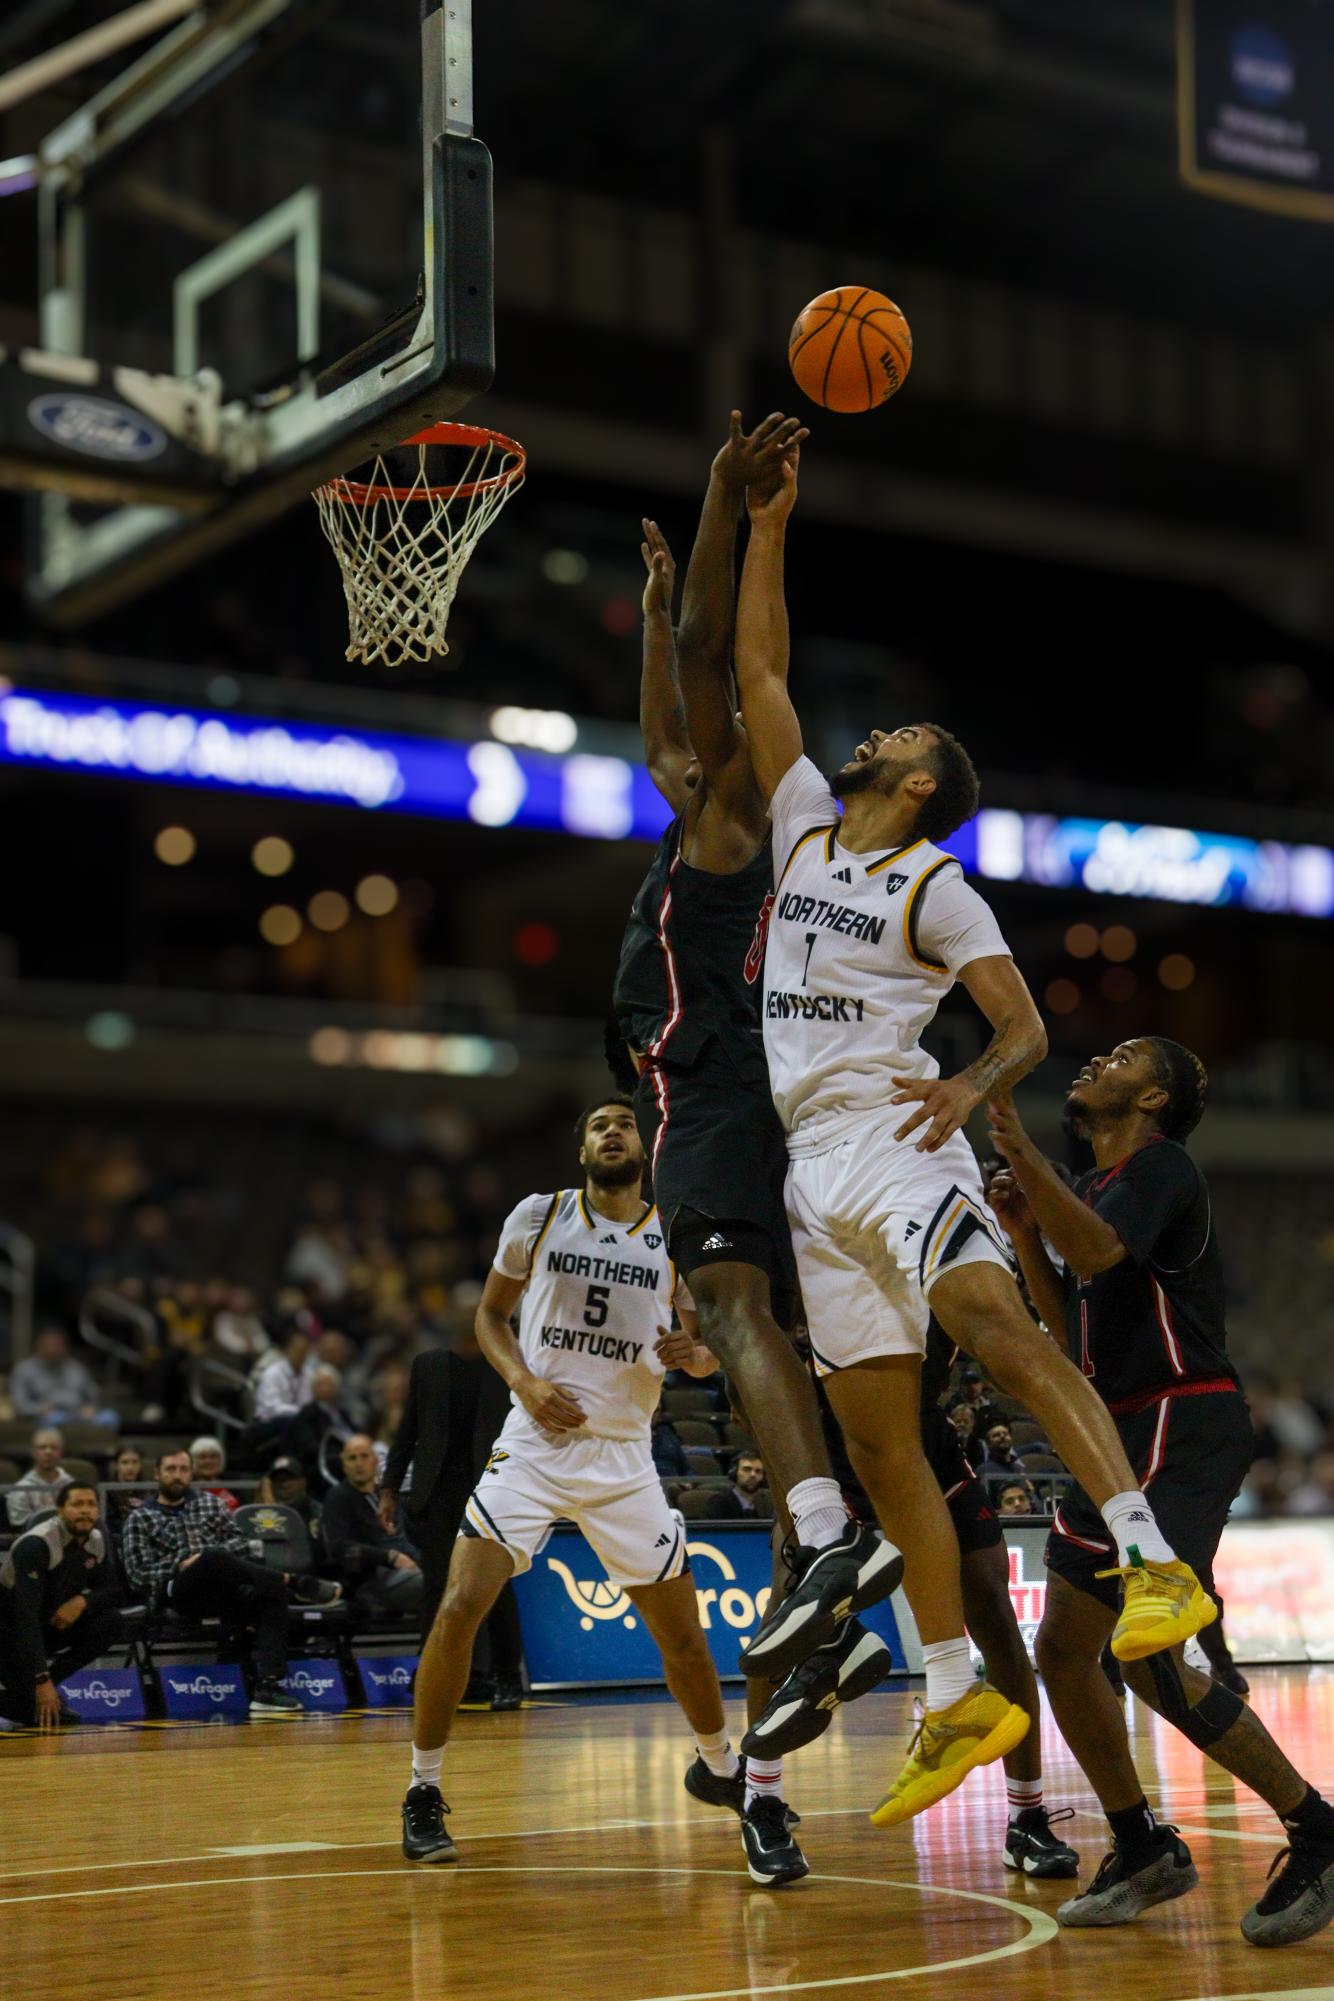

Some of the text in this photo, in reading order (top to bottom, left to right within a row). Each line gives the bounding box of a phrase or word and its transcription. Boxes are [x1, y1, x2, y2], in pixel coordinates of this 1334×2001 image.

[778, 892, 887, 945] NORTHERN
[801, 932, 818, 987] 1
[766, 990, 864, 1022] KENTUCKY
[547, 1251, 660, 1291] NORTHERN
[583, 1284, 611, 1328] 5
[541, 1326, 644, 1364] KENTUCKY
[84, 1681, 133, 1707] Kroger
[190, 1676, 237, 1702] Kroger
[290, 1671, 336, 1697] Kroger
[388, 1667, 411, 1686] Kro
